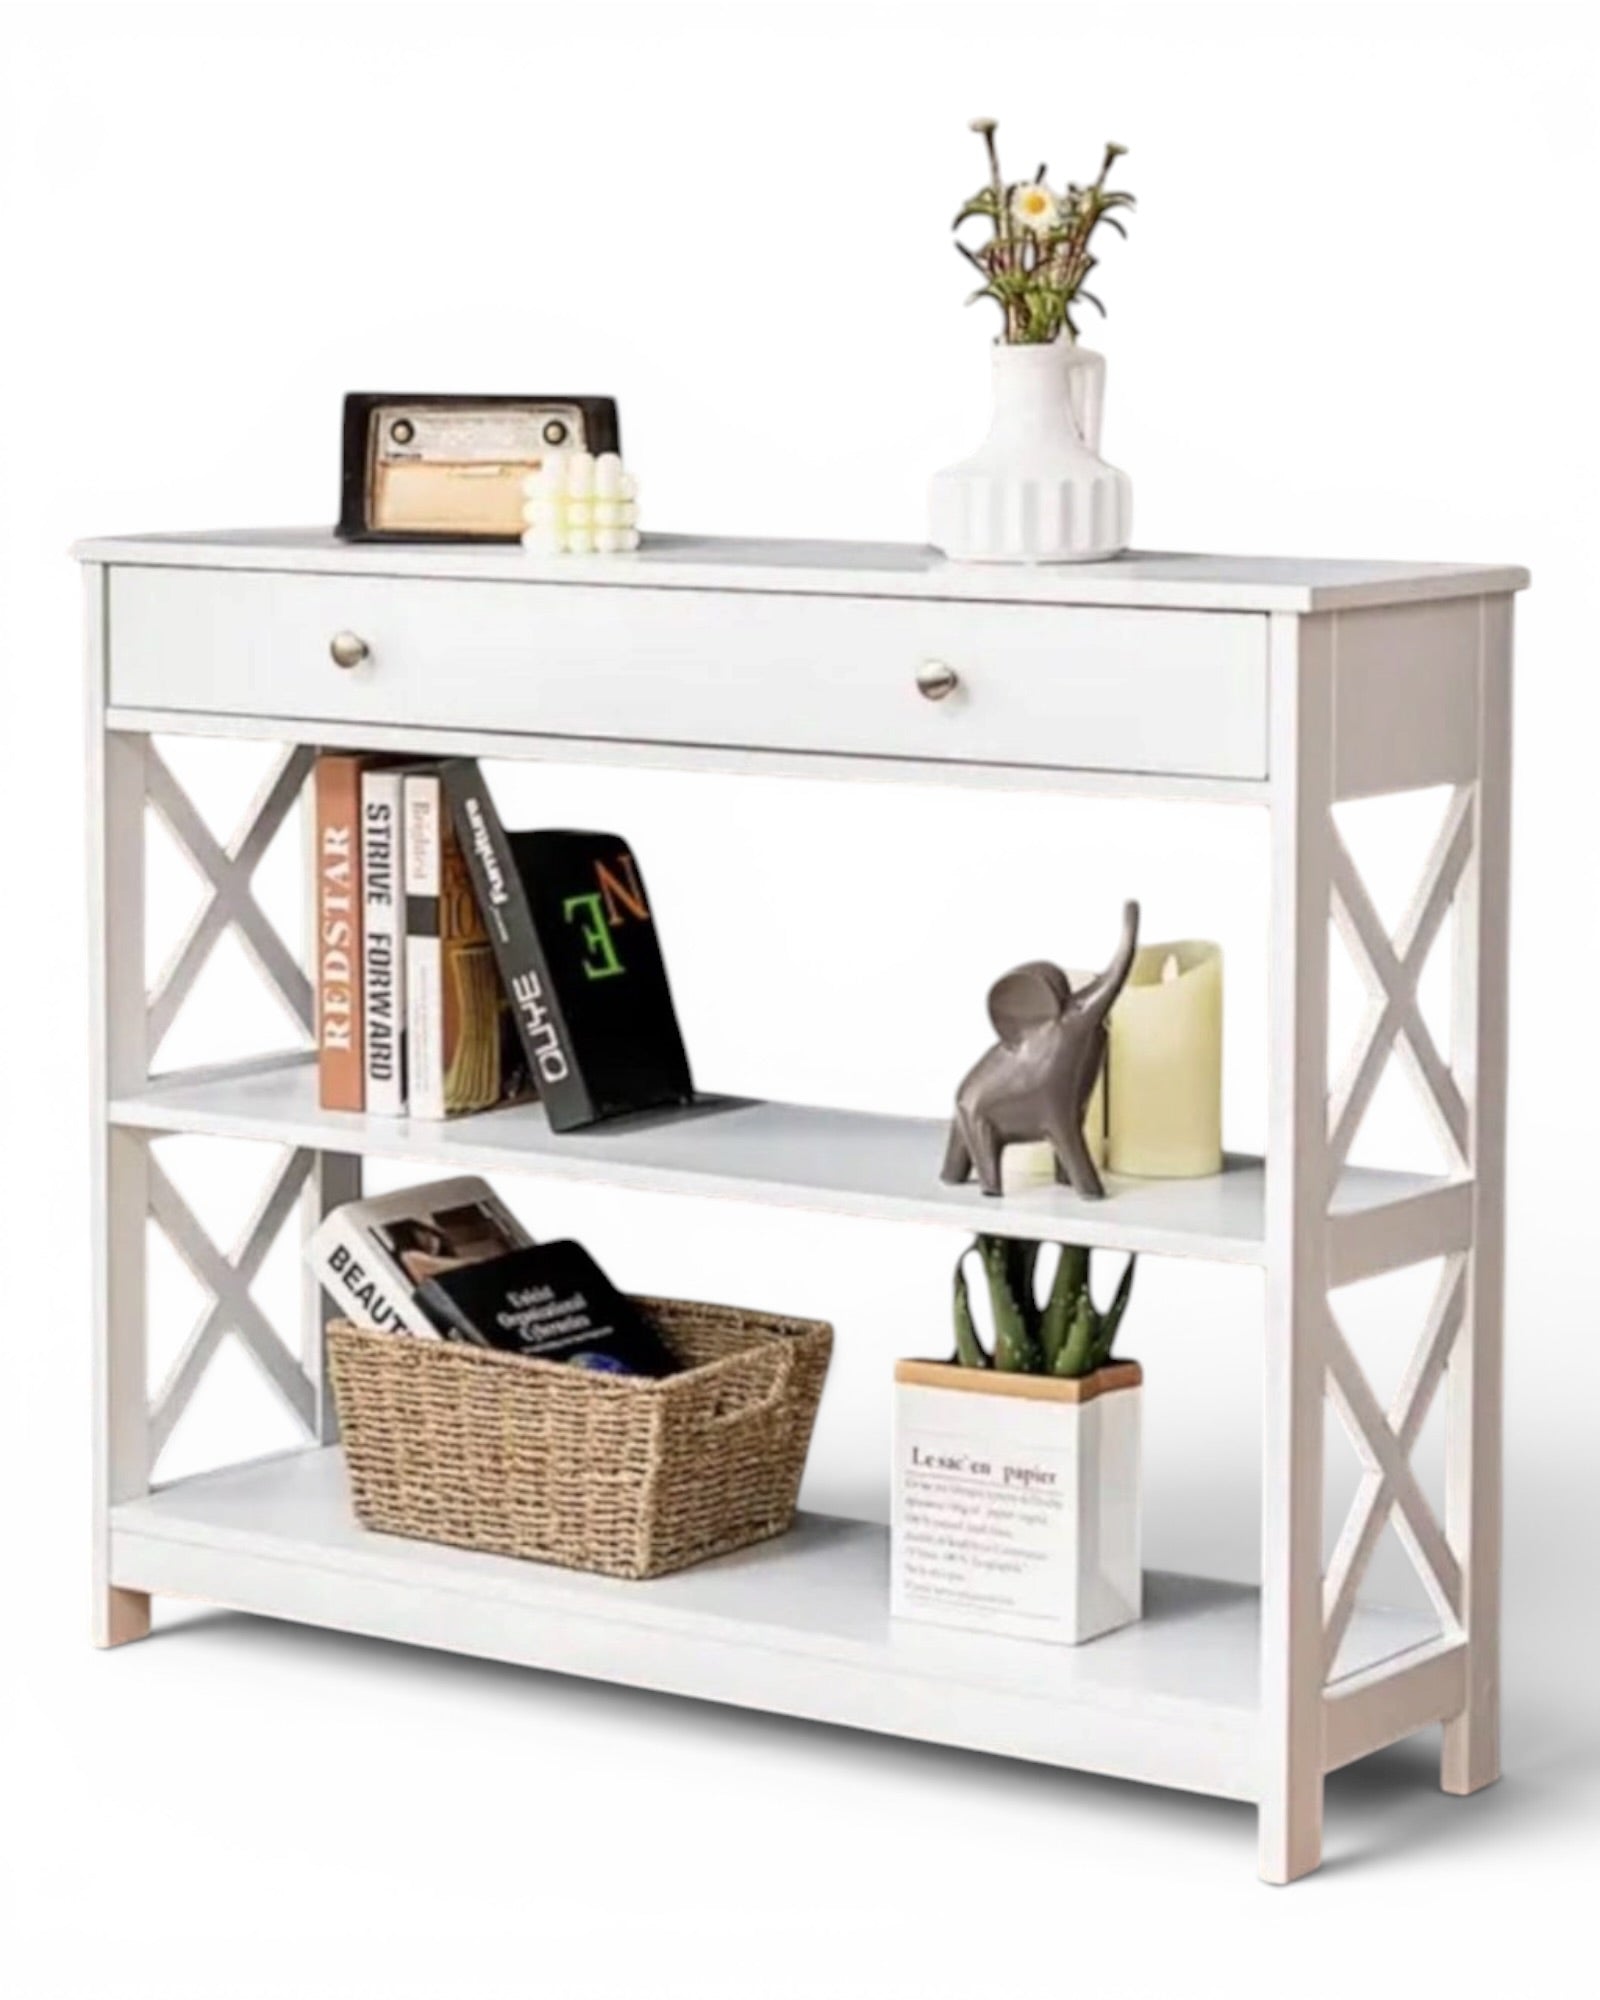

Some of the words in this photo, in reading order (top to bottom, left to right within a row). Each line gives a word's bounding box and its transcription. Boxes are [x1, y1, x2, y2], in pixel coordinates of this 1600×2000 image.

[366, 802, 392, 906] STRIVE
[465, 797, 509, 905] Furniture
[323, 826, 351, 1050] REDSTAR
[367, 932, 393, 1082] FORWARD
[512, 970, 569, 1084] OUYE
[327, 1243, 414, 1338] BEAUT
[911, 1446, 933, 1468] Le
[970, 1460, 992, 1475] en
[1003, 1463, 1057, 1486] papier
